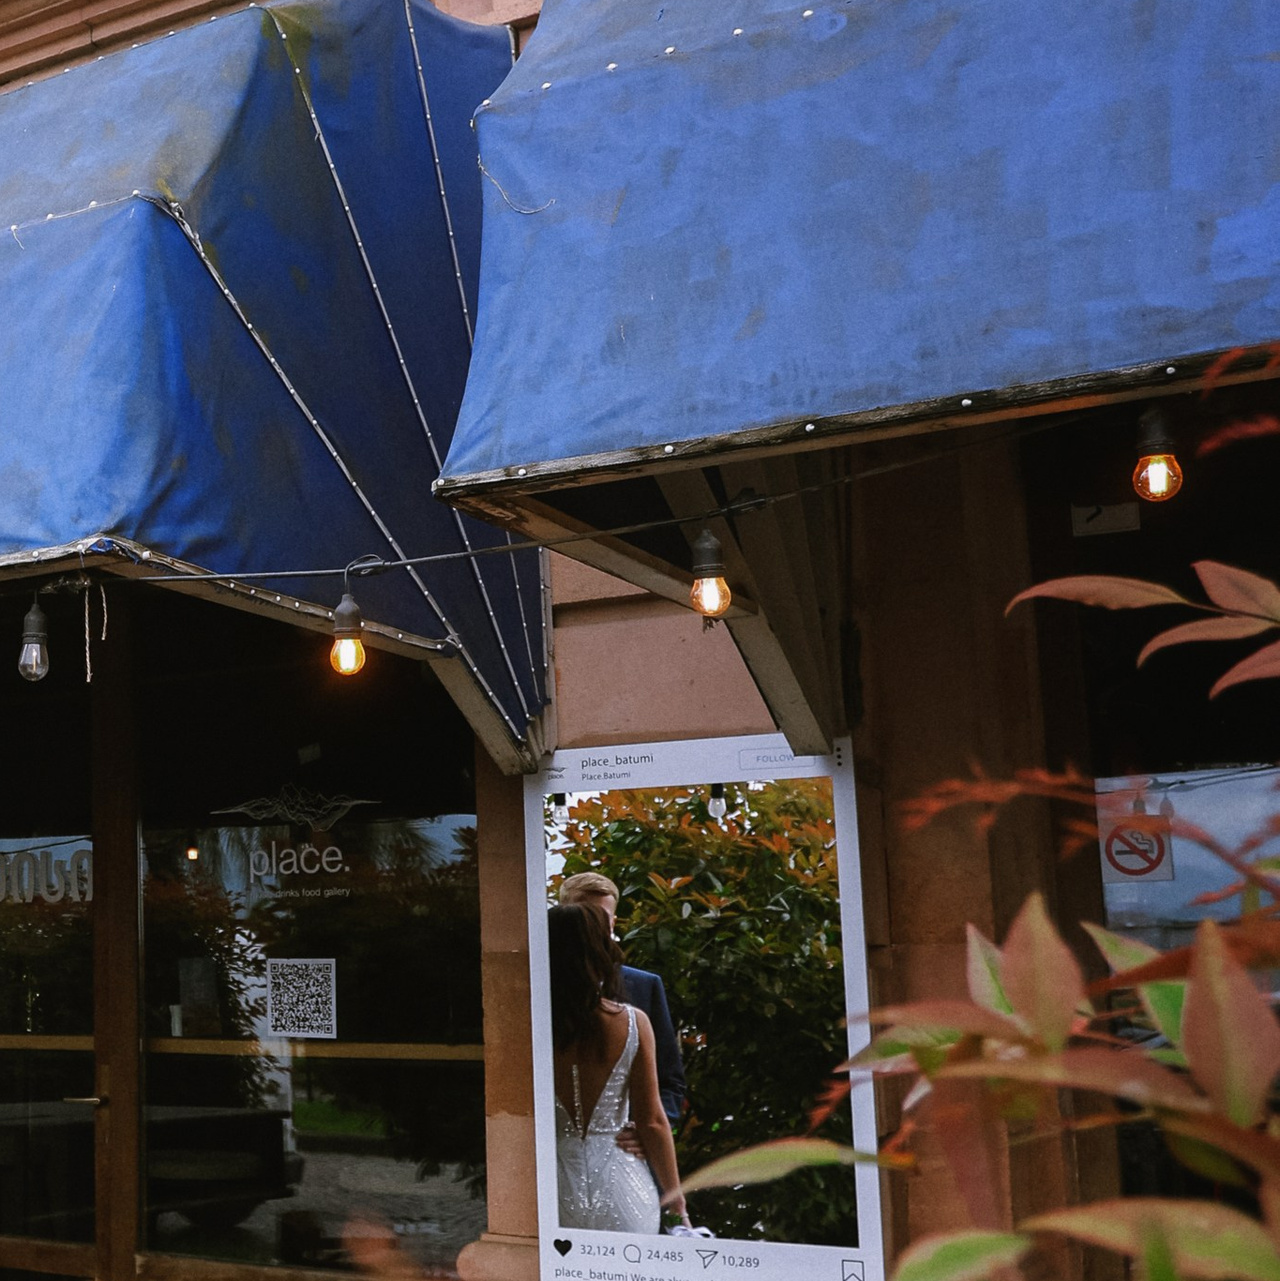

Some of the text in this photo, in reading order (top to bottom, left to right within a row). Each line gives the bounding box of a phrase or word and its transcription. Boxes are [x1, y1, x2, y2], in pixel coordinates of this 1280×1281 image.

[580, 753, 654, 769] place_batumi
[756, 754, 795, 763] FOLLOW
[581, 770, 631, 782] Place.Batumi
[248, 840, 351, 884] place.
[275, 888, 300, 899] drinks
[302, 887, 322, 898] food
[323, 886, 352, 899] gallery
[580, 1243, 616, 1258] 32,124
[646, 1249, 684, 1263] 24,485
[722, 1254, 760, 1269] 10,289
[555, 1267, 628, 1281] place_batumi
